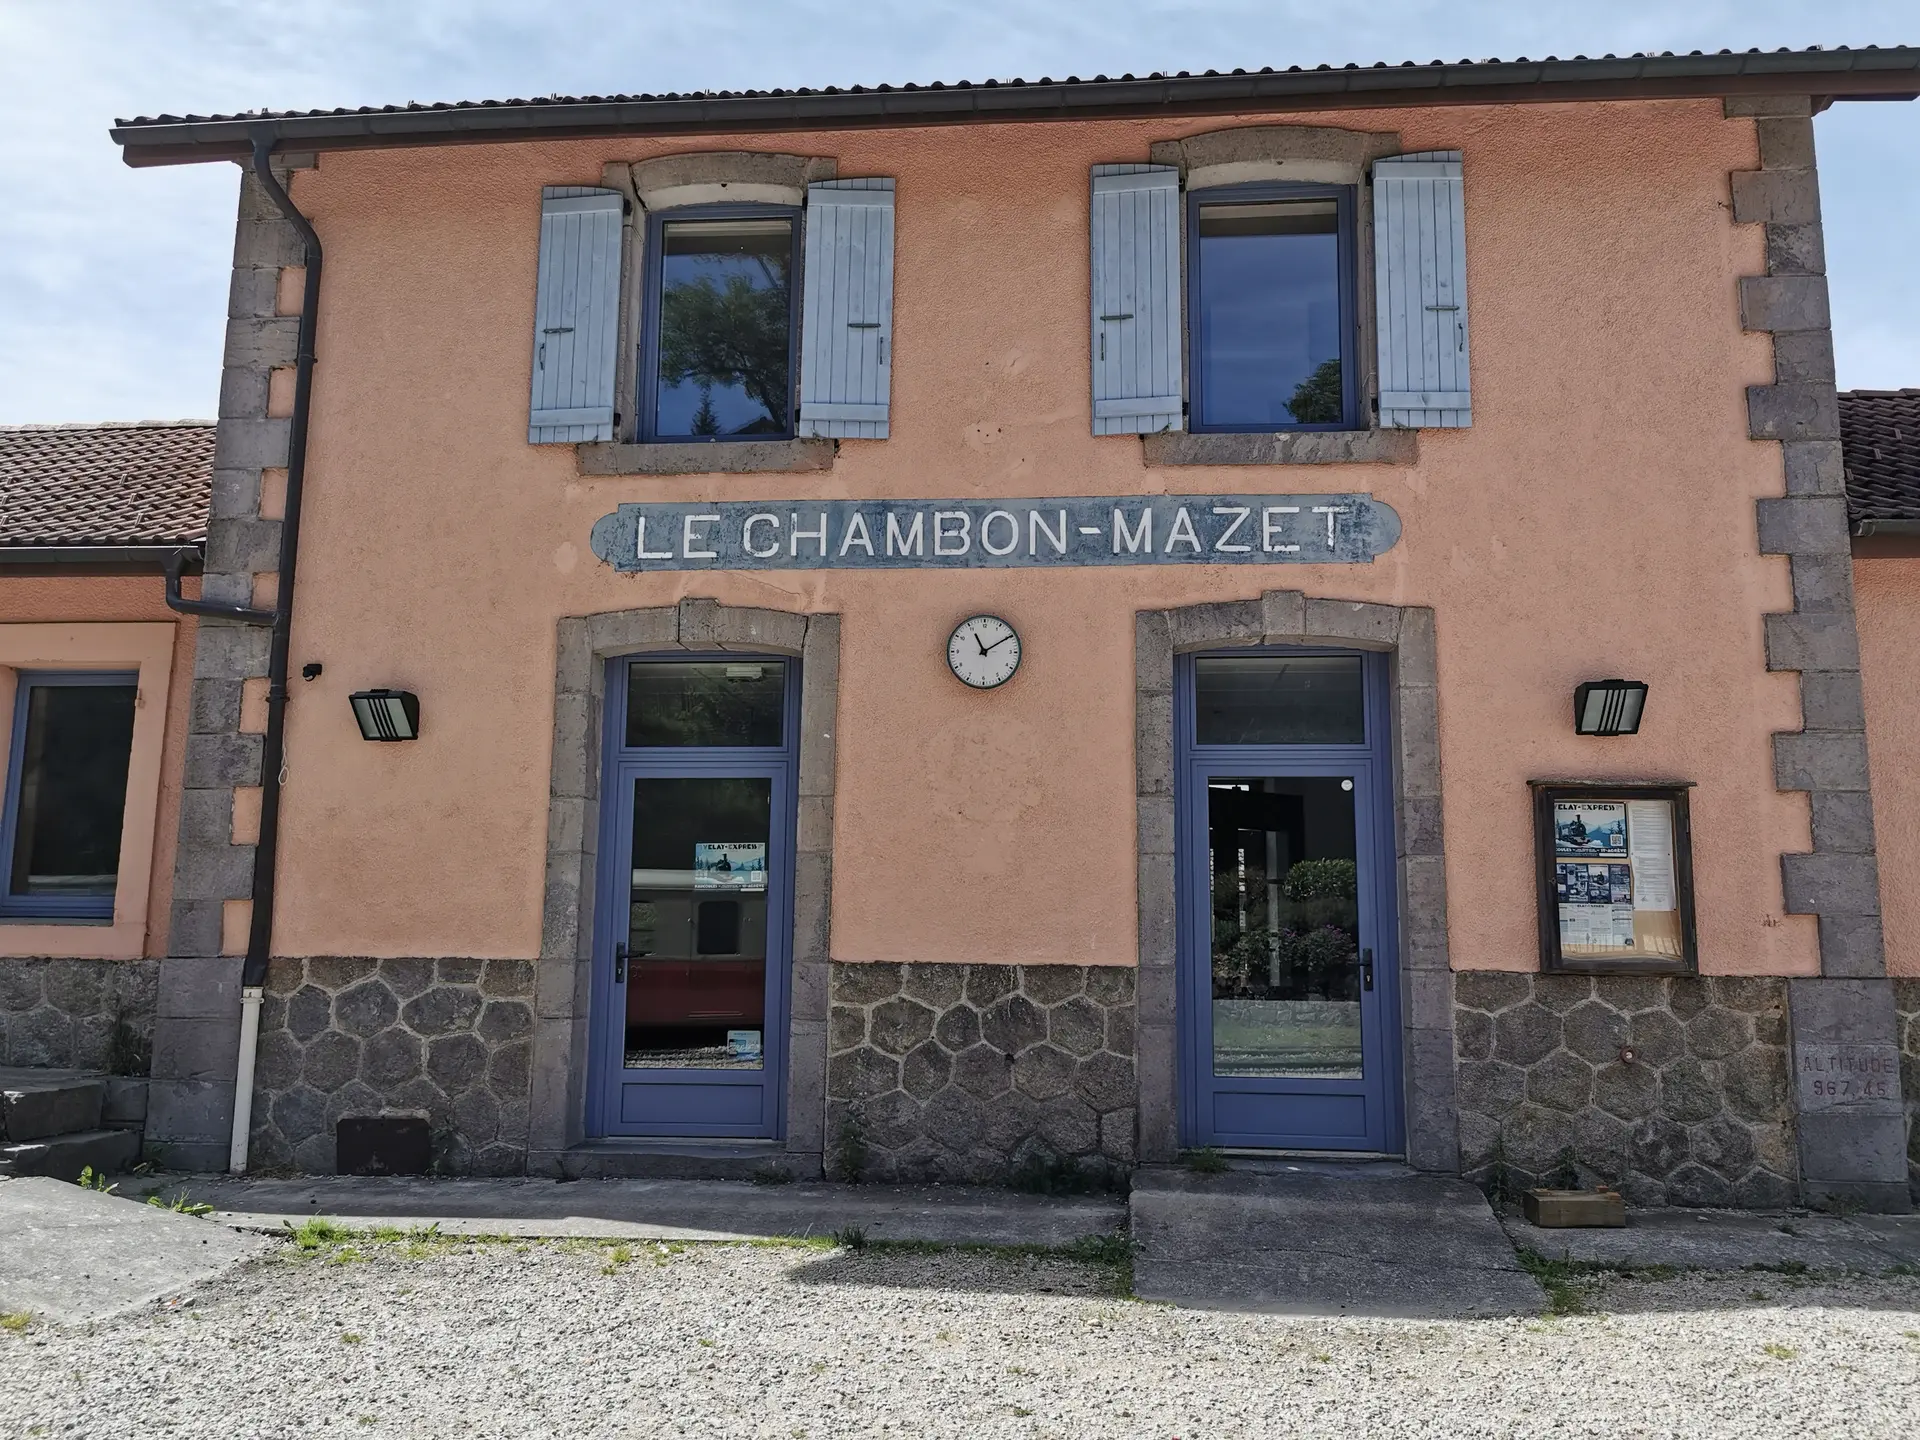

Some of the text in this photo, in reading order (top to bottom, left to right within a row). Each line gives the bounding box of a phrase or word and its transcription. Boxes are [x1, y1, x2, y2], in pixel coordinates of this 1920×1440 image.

[636, 505, 1350, 560] LE CHAMBON-MAZET
[1803, 1056, 1894, 1074] ALTITUDE
